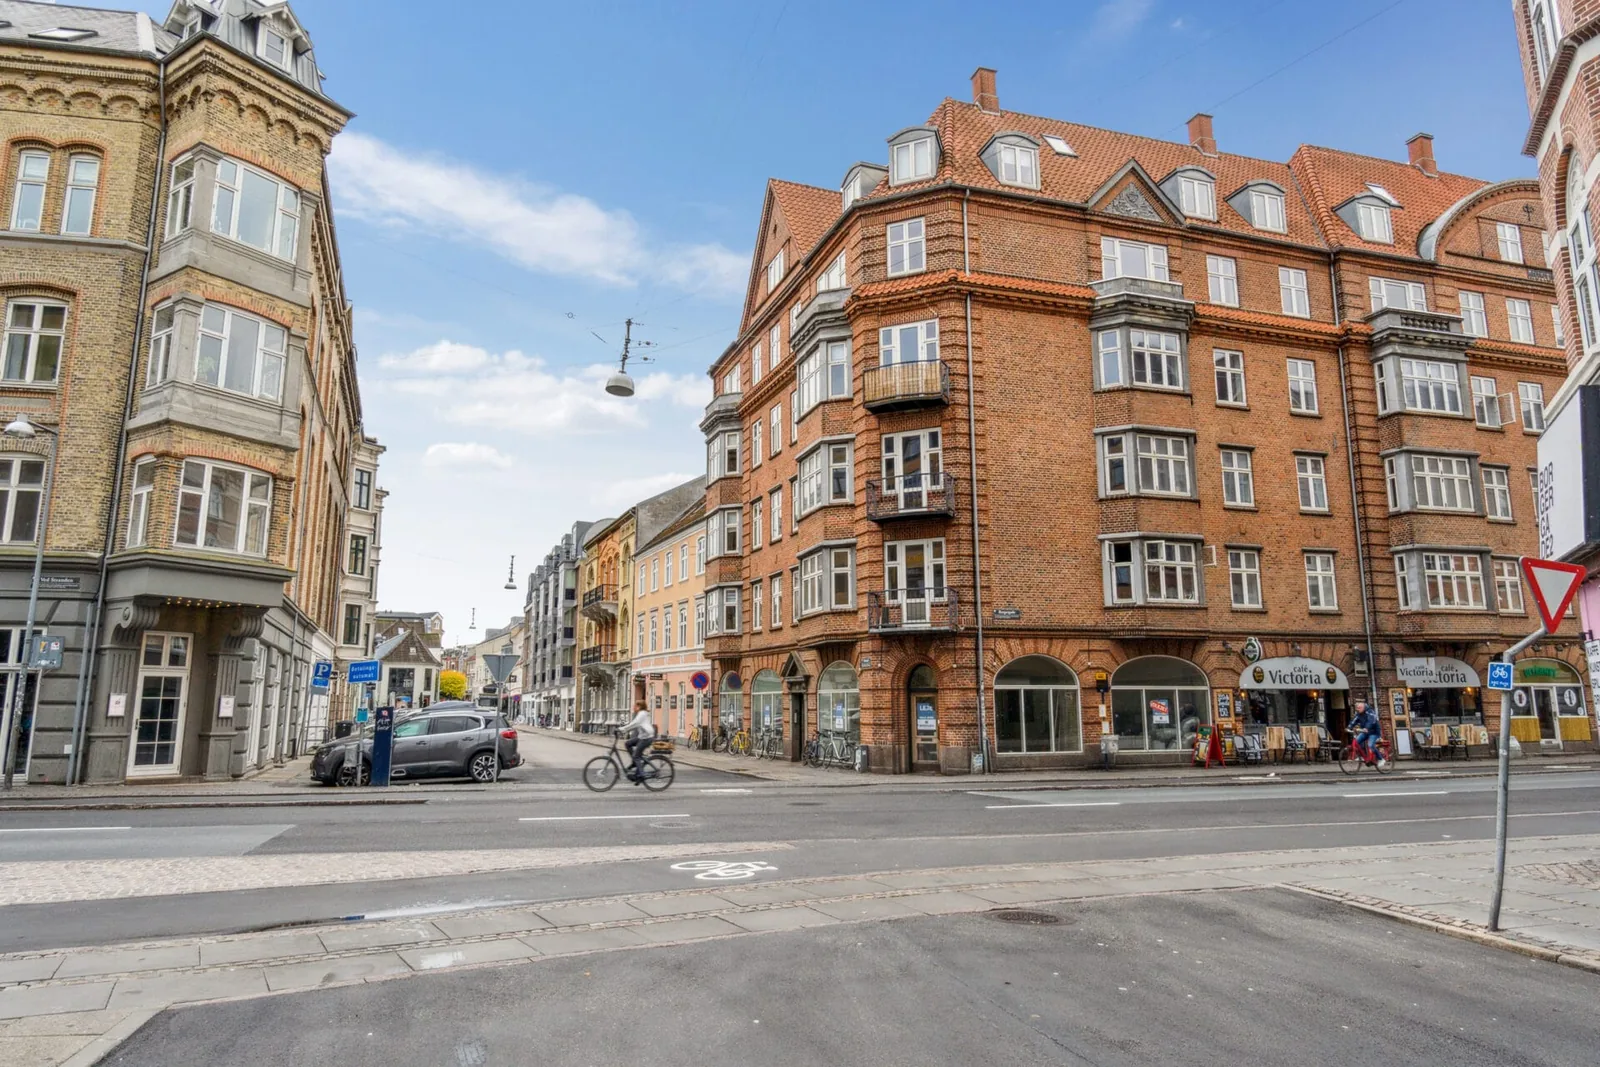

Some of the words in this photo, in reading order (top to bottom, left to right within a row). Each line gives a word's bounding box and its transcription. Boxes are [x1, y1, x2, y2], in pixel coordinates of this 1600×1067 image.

[1539, 461, 1554, 493] BOR
[1540, 485, 1554, 515] GER
[317, 664, 329, 676] P
[1293, 664, 1309, 673] café
[1400, 668, 1434, 677] Victoria
[1268, 669, 1322, 685] Victoria
